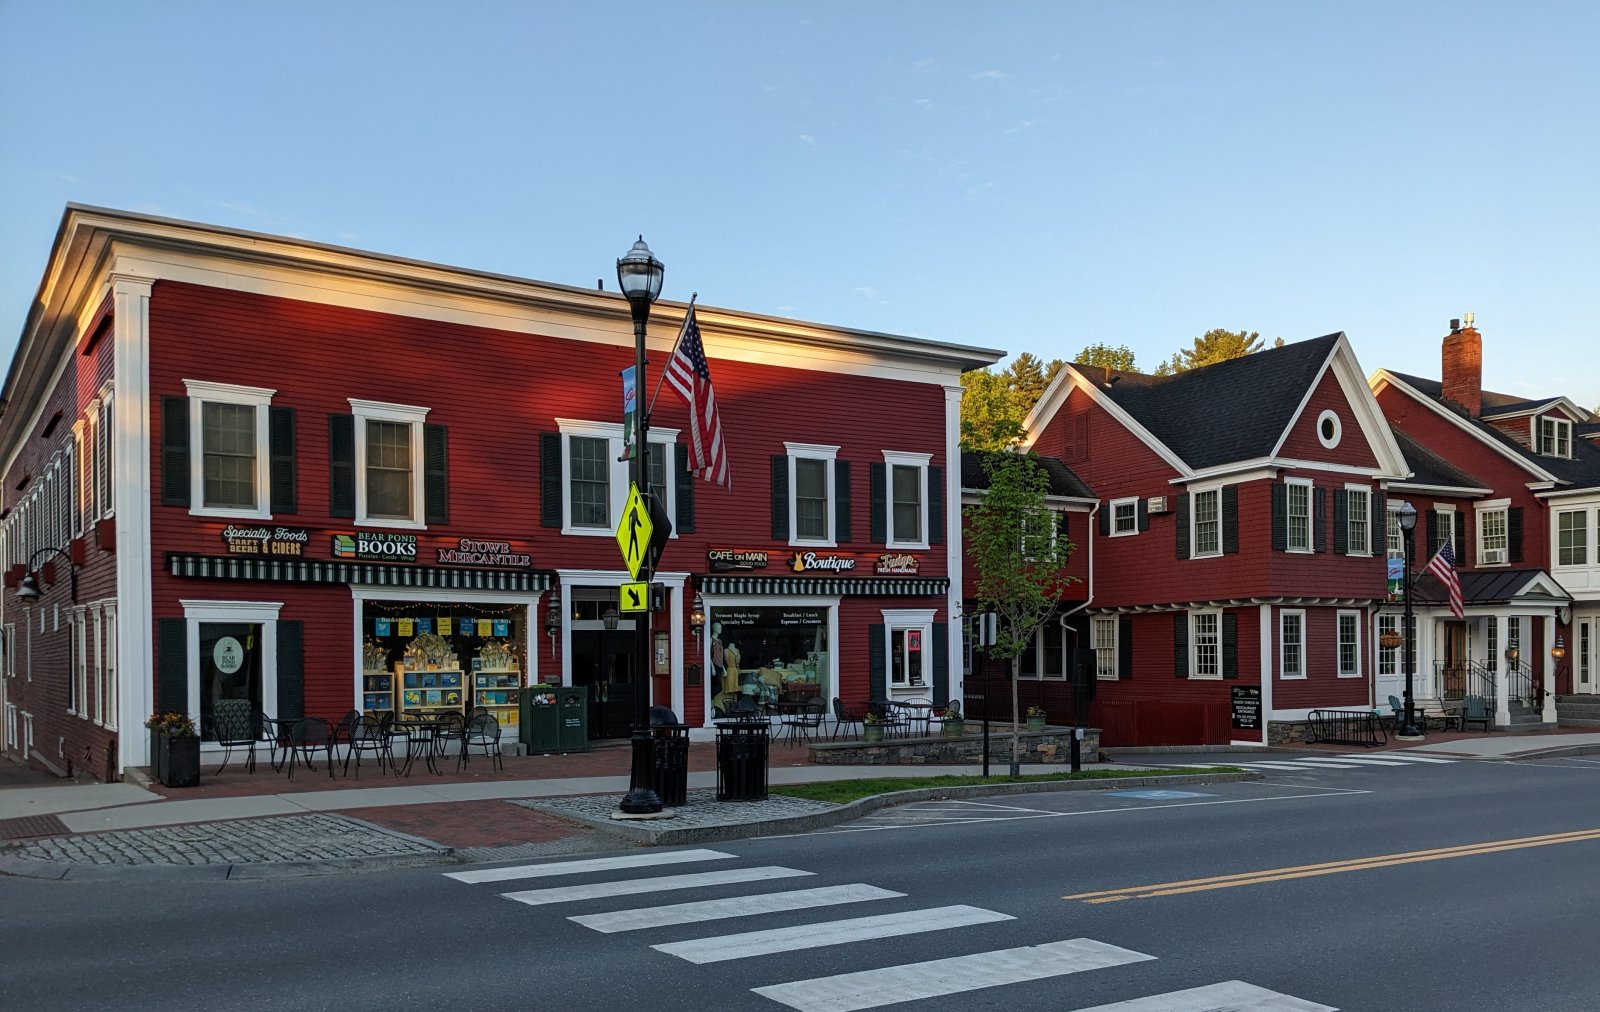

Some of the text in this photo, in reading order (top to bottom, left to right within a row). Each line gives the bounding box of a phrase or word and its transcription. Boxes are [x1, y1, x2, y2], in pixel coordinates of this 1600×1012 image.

[224, 525, 308, 544] Specialty Foods
[358, 532, 416, 542] BEAR POND
[262, 542, 301, 555] & CIDERS
[358, 540, 416, 556] BOOKS
[709, 549, 733, 560] CAFÉ
[745, 552, 767, 561] MAIN
[804, 552, 855, 572] Boutique
[880, 554, 914, 568] Fudge
